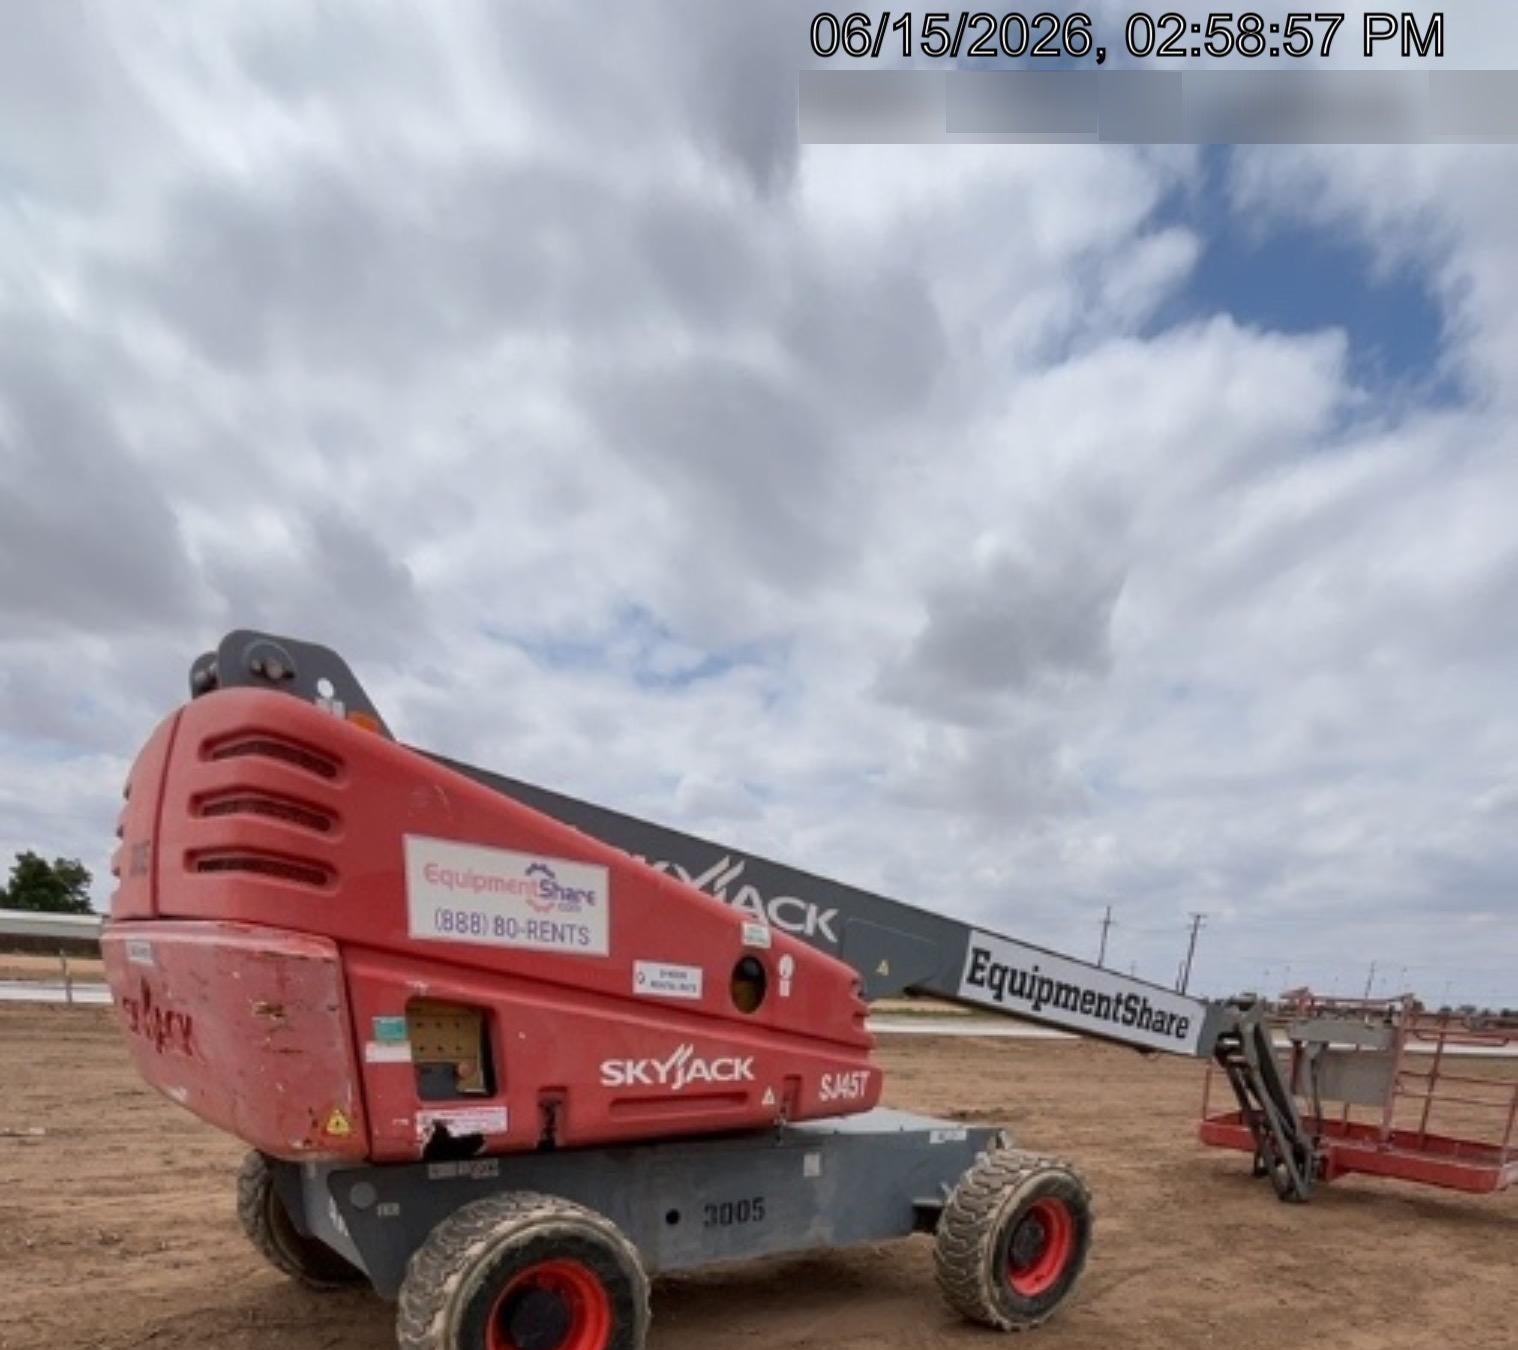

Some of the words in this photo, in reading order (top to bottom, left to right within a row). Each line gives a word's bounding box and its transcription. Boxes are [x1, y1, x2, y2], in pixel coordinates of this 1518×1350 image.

[435, 906, 488, 937] (888)
[494, 914, 592, 946] 80-RENTS
[966, 947, 1190, 1039] EquipmentShare
[600, 1043, 755, 1090] SKYJACK
[818, 1071, 871, 1101] SJ45T
[704, 1197, 765, 1228] 3005
